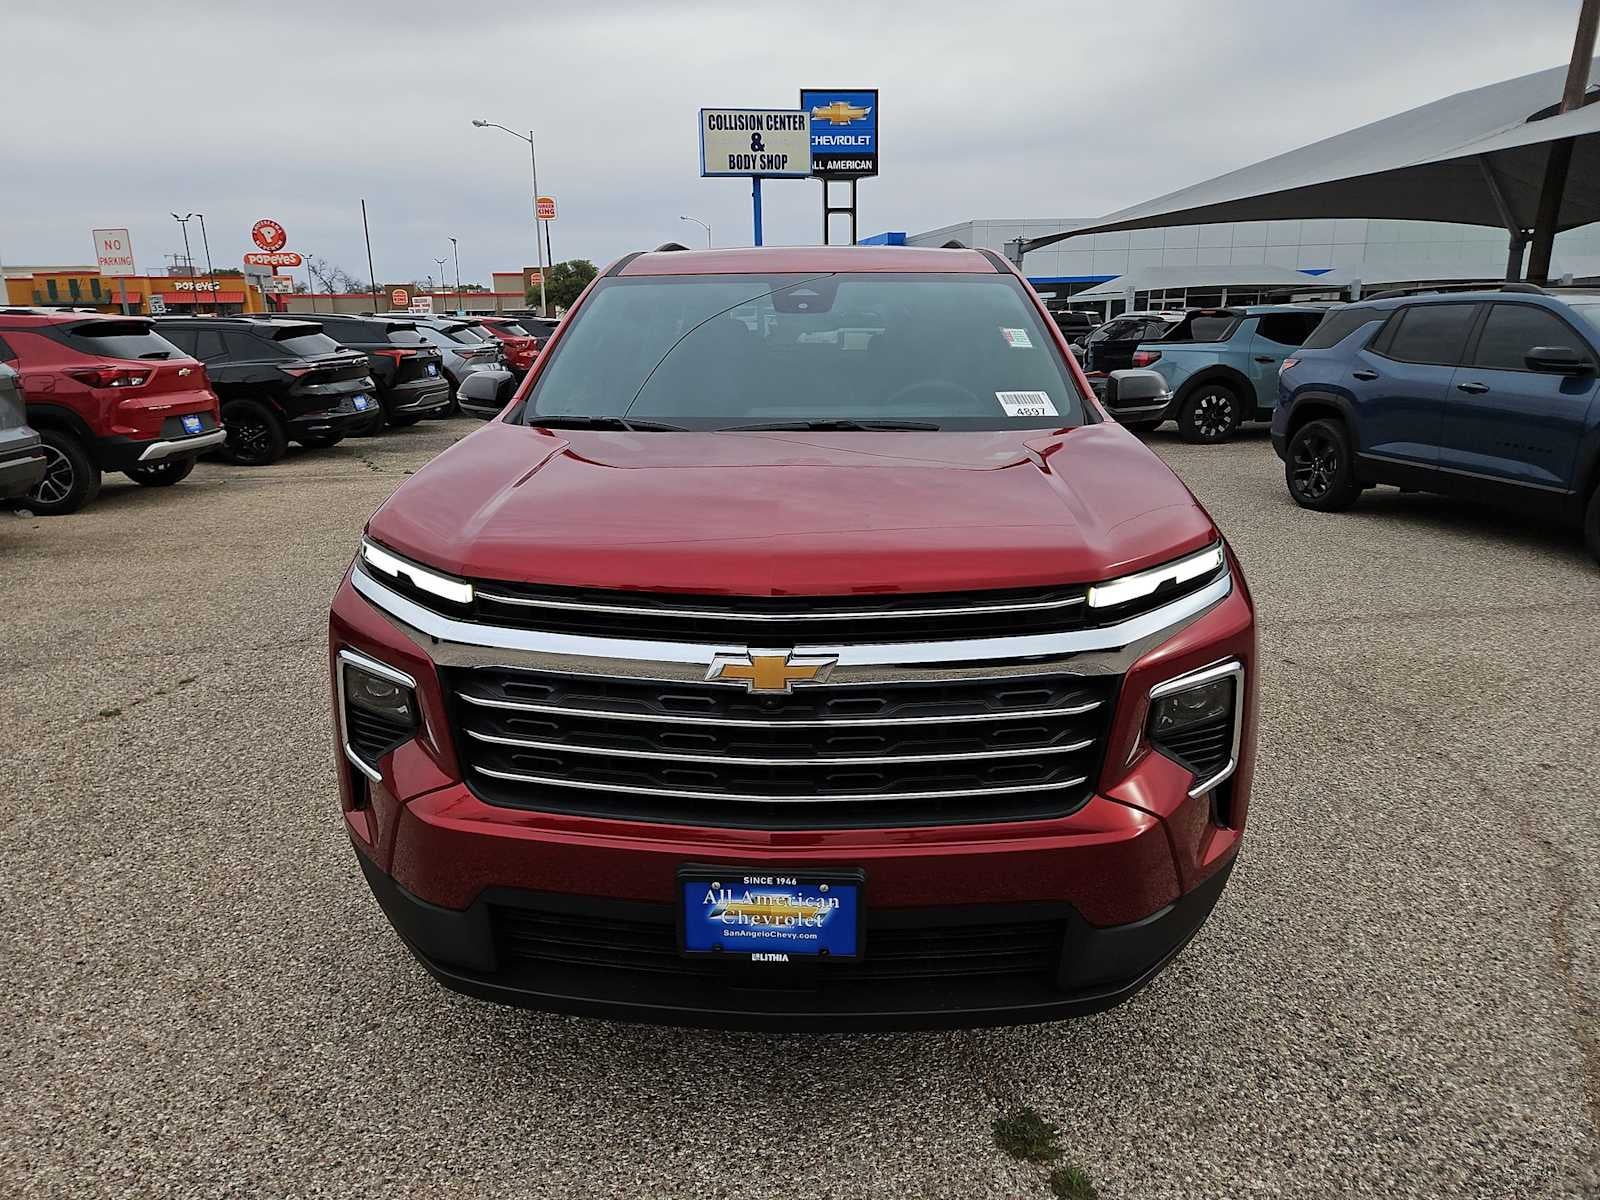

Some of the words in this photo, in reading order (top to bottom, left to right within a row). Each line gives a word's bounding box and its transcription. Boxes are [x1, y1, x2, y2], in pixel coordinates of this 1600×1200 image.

[708, 114, 763, 131] COLLISION
[766, 114, 805, 131] CENTER
[750, 132, 765, 152] &
[728, 154, 757, 170] BODY
[759, 154, 788, 170] SHOP
[827, 160, 873, 170] AMERICAN
[104, 239, 121, 251] NO
[99, 256, 132, 266] PARKING
[151, 304, 165, 312] 35
[743, 876, 773, 885] SINCE
[776, 877, 797, 886] 1946
[703, 889, 732, 905] All
[741, 890, 840, 908] American
[721, 909, 824, 928] Chevrolet
[723, 929, 817, 940] SanAngeloChevy.com
